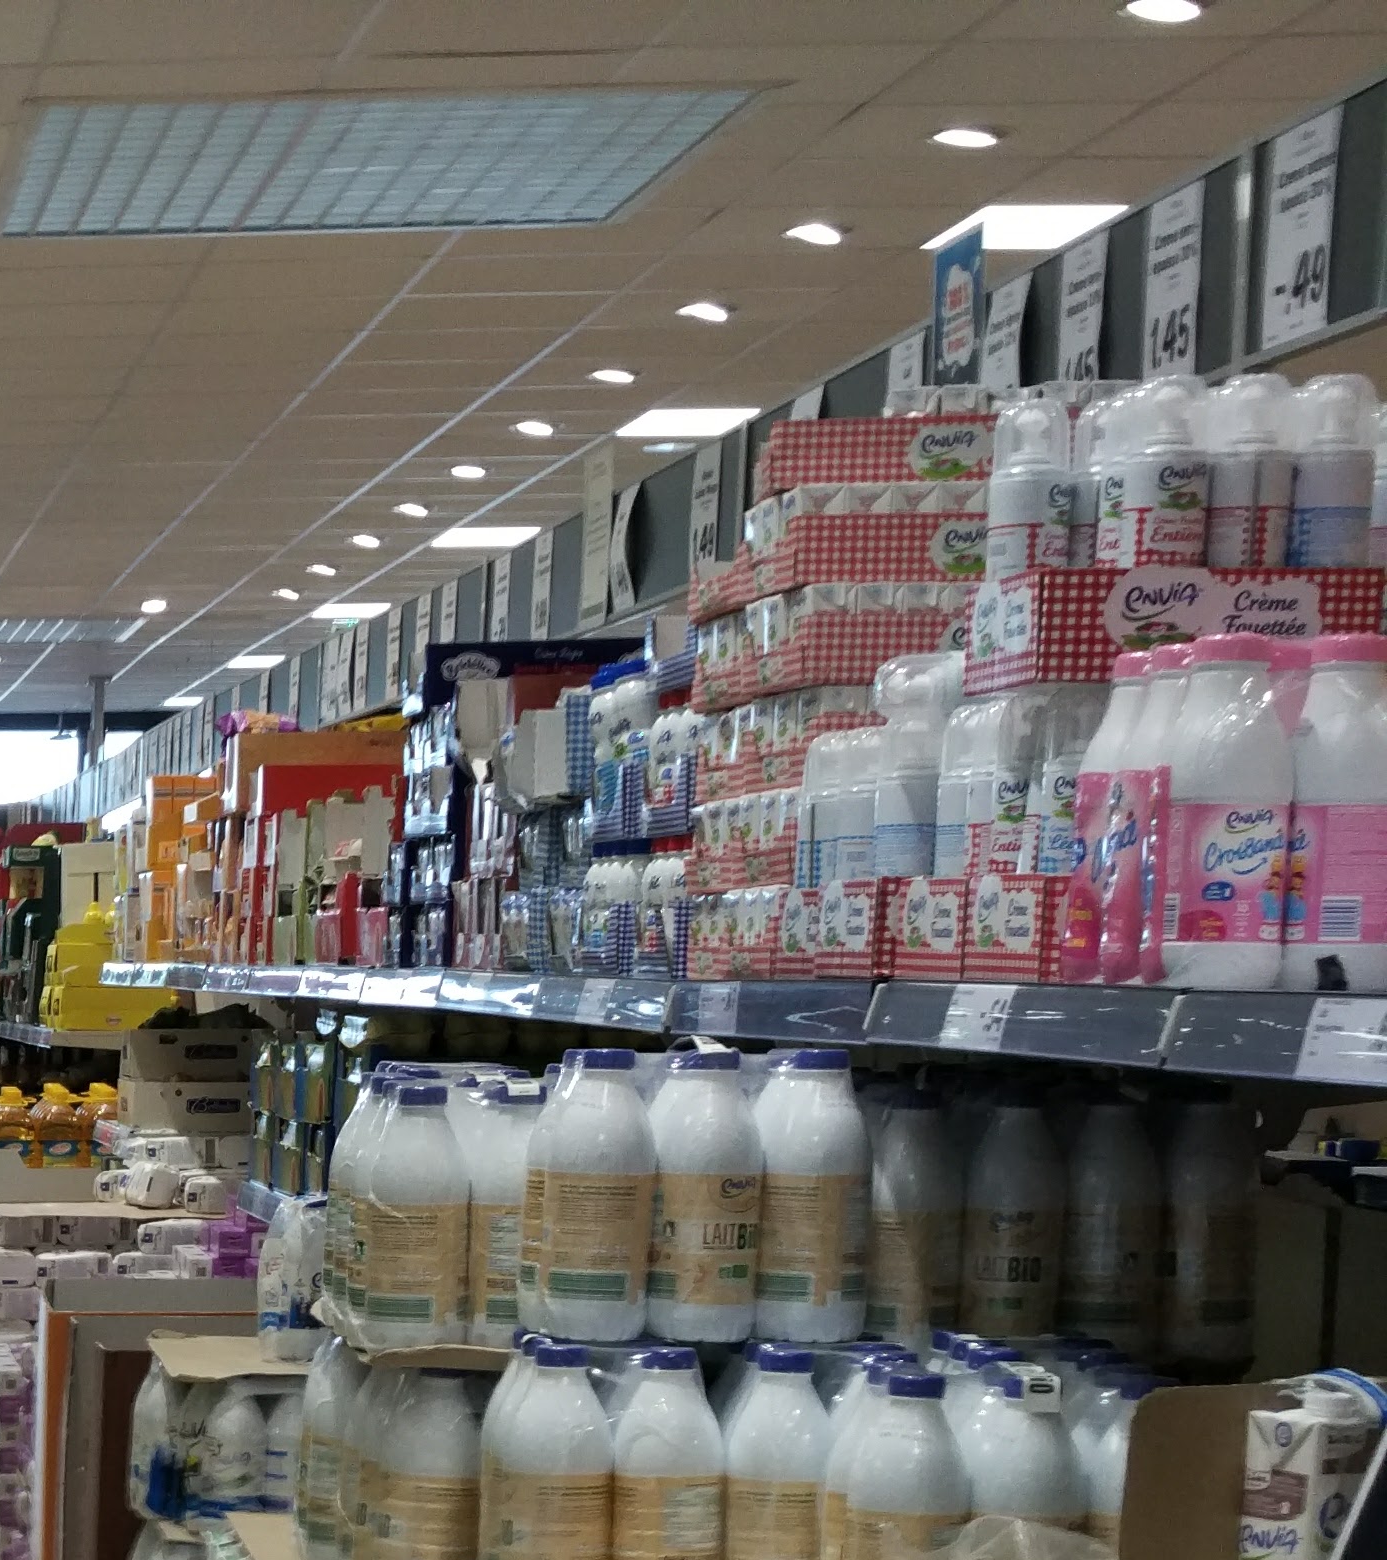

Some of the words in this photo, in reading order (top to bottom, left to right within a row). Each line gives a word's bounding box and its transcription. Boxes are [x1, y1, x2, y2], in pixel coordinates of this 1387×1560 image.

[1151, 303, 1190, 369] 1.45
[1232, 589, 1300, 613] Crème
[1221, 614, 1308, 637] Fouettée
